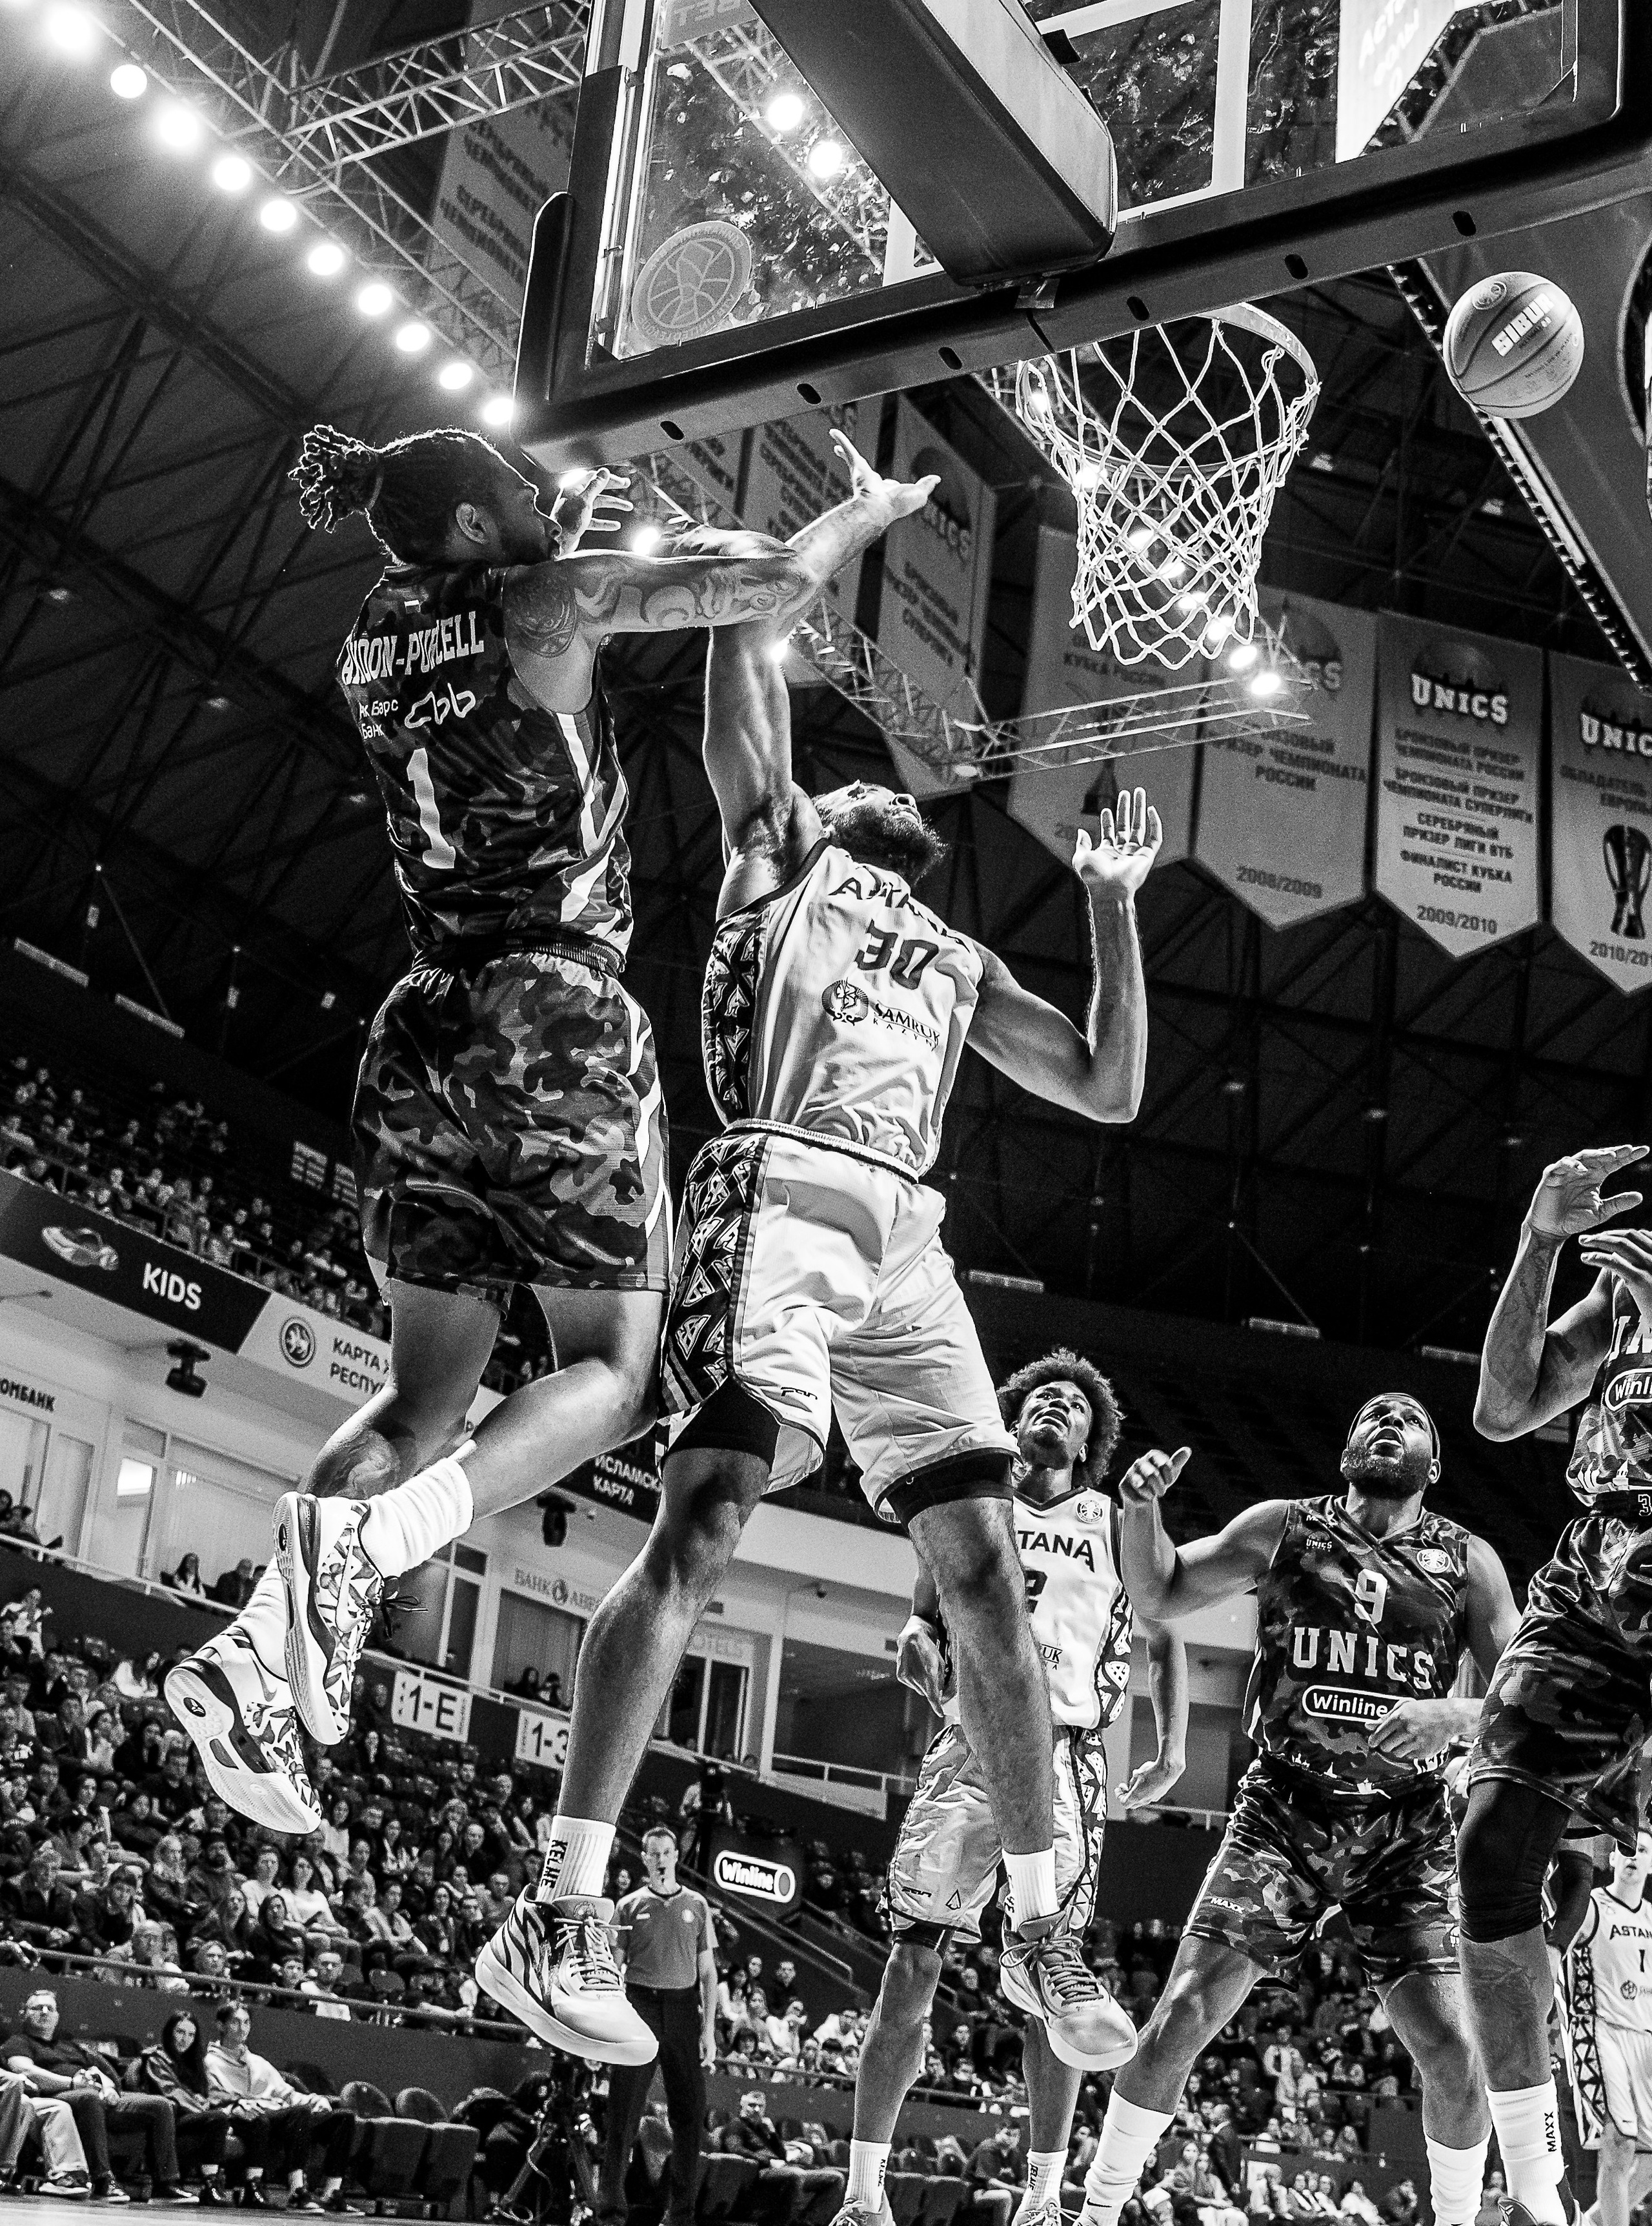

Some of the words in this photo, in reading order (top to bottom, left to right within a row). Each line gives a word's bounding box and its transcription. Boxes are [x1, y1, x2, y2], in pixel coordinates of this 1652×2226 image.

[1411, 673, 1509, 725] UNICS
[406, 747, 456, 869] 1
[1235, 864, 1323, 899] 2008/2009
[1417, 905, 1498, 935] 2009/2010
[854, 919, 939, 990] 30
[143, 1262, 202, 1311] KIDS
[332, 1337, 381, 1372] КАРТА
[329, 1361, 387, 1395] РЕСПУ
[592, 1474, 634, 1506] КАРТА
[1017, 1530, 1095, 1573] TANA
[1306, 1539, 1333, 1550] UNICS
[1355, 1568, 1388, 1625] 9
[1293, 1626, 1435, 1690] UNICS
[1313, 1692, 1388, 1717] Winline
[722, 1859, 774, 1891] Winline
[1210, 1897, 1245, 1914] MAXX
[1544, 2110, 1557, 2152] MAXX
